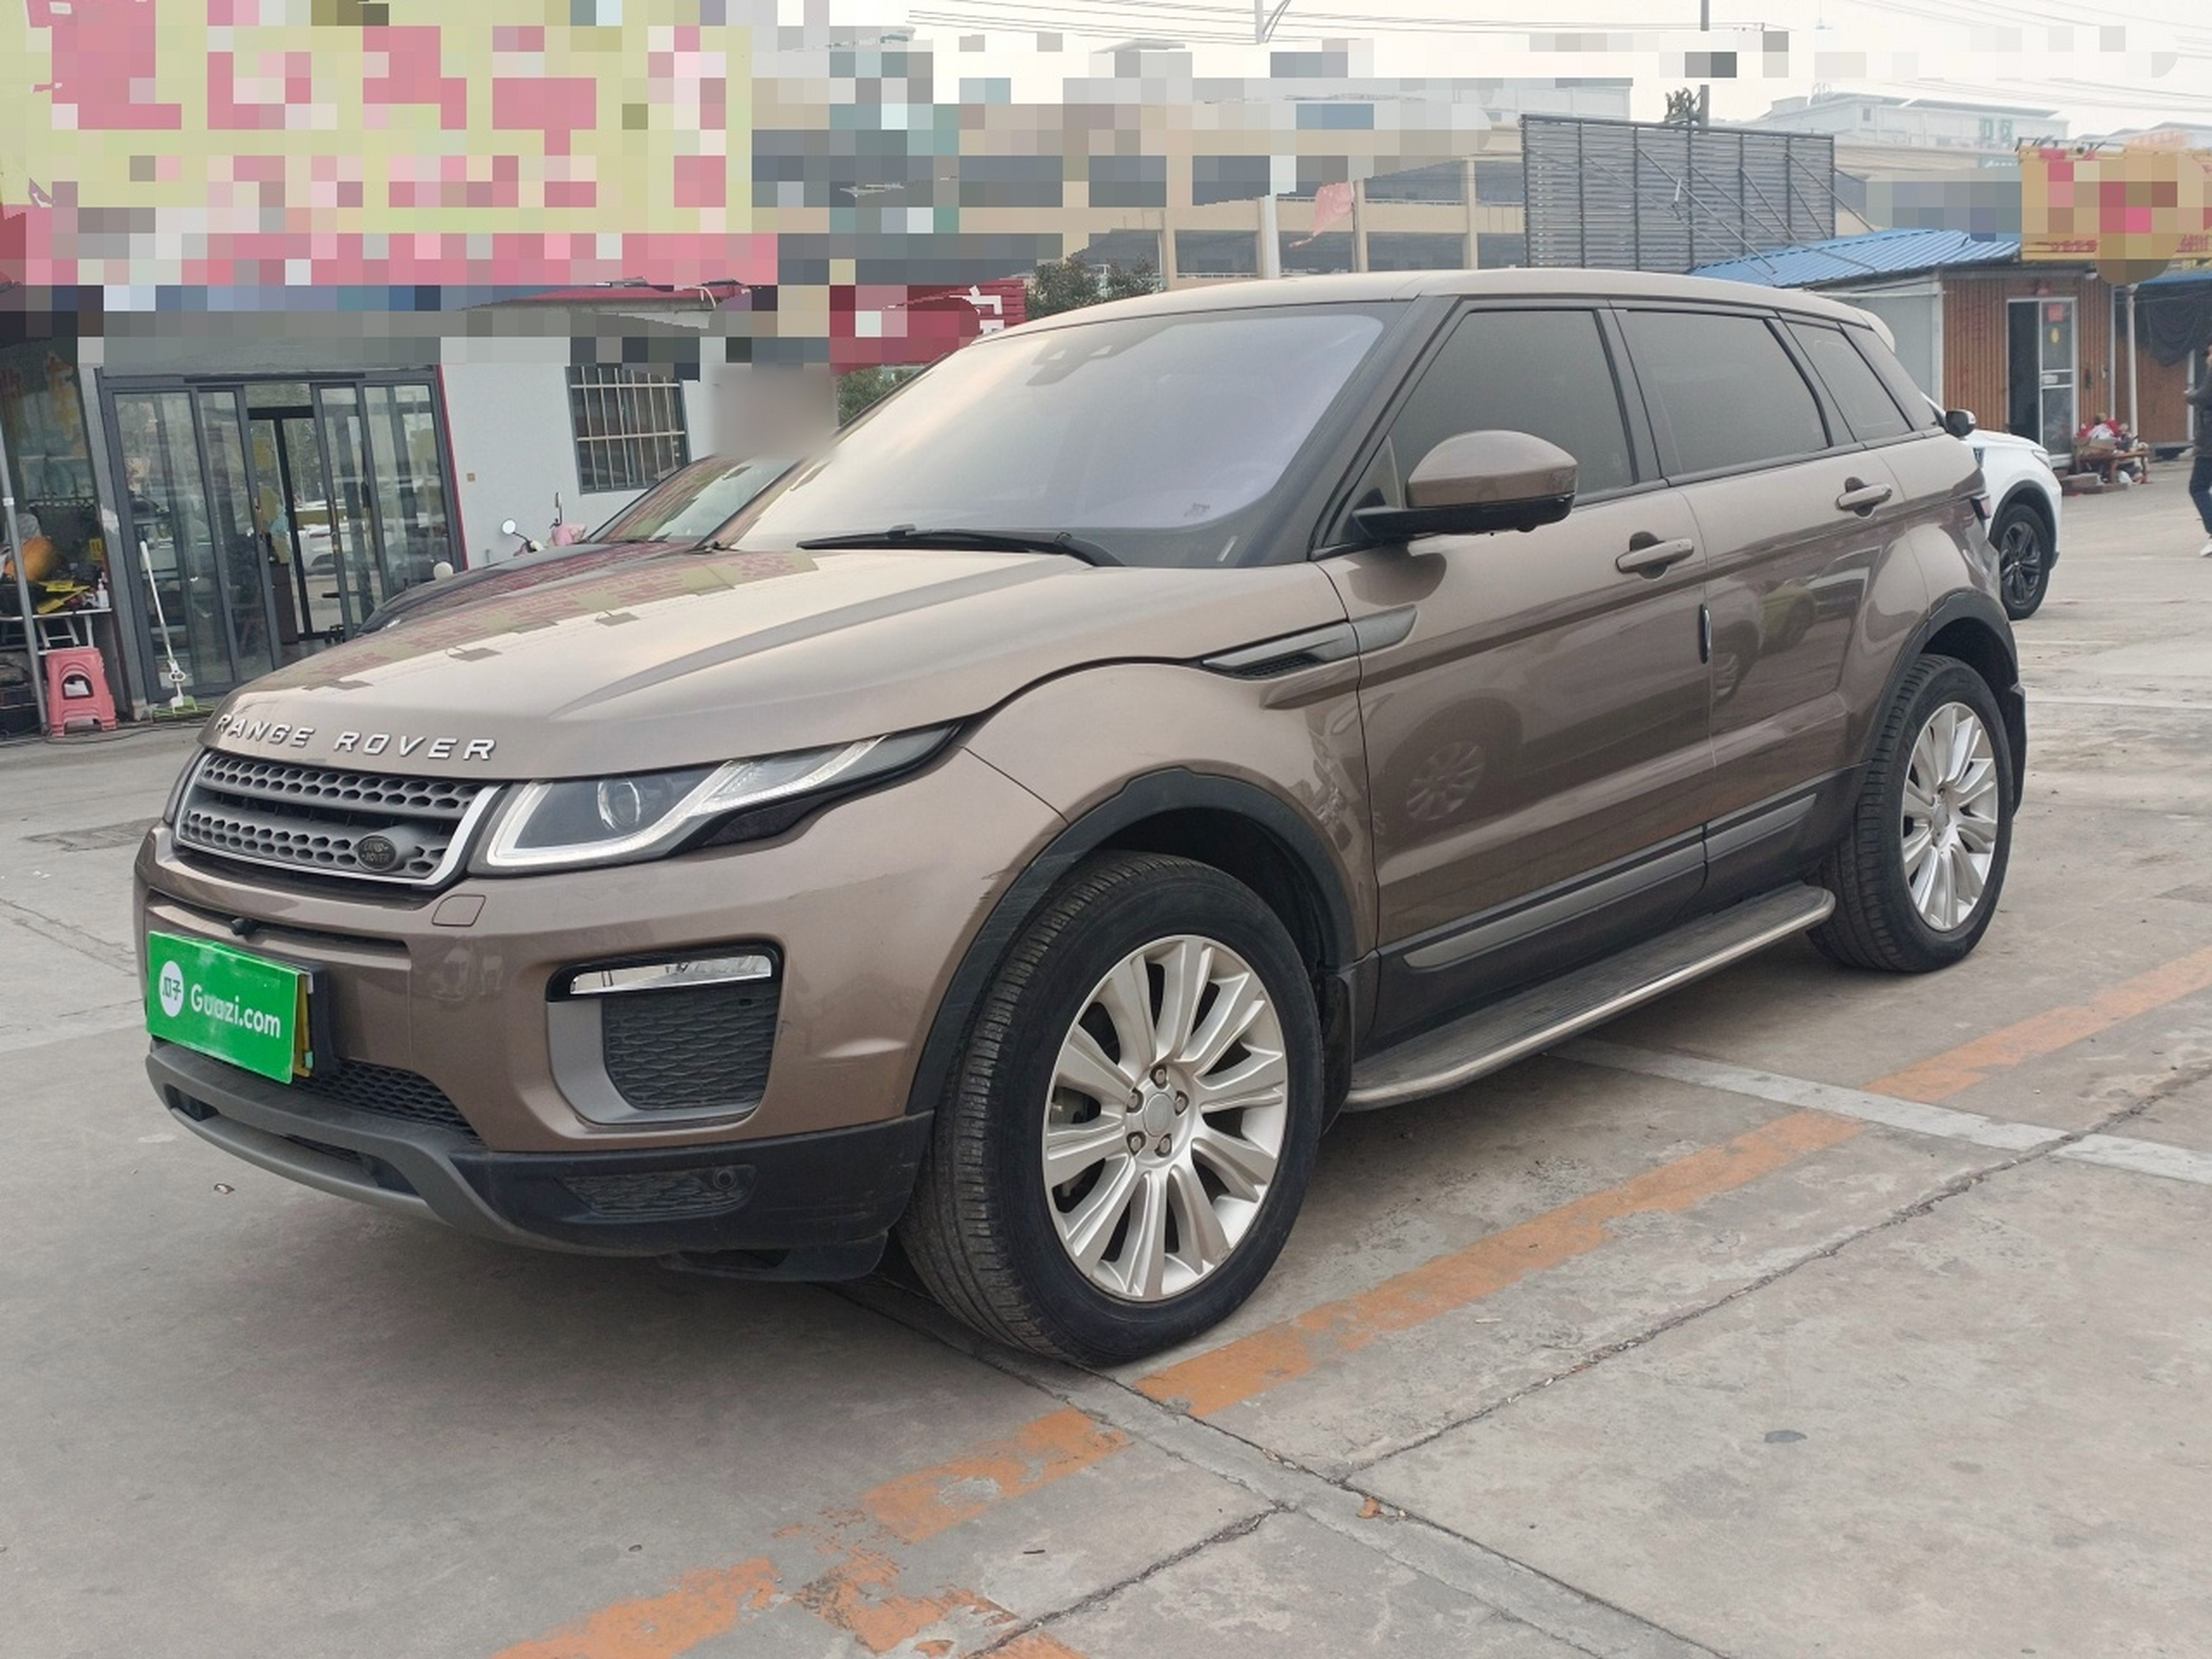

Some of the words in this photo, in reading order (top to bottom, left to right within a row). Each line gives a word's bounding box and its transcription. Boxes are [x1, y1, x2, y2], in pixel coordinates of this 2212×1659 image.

[214, 714, 316, 747] RANGE
[334, 730, 496, 760] ROVER
[191, 983, 281, 1038] Guazi.com
